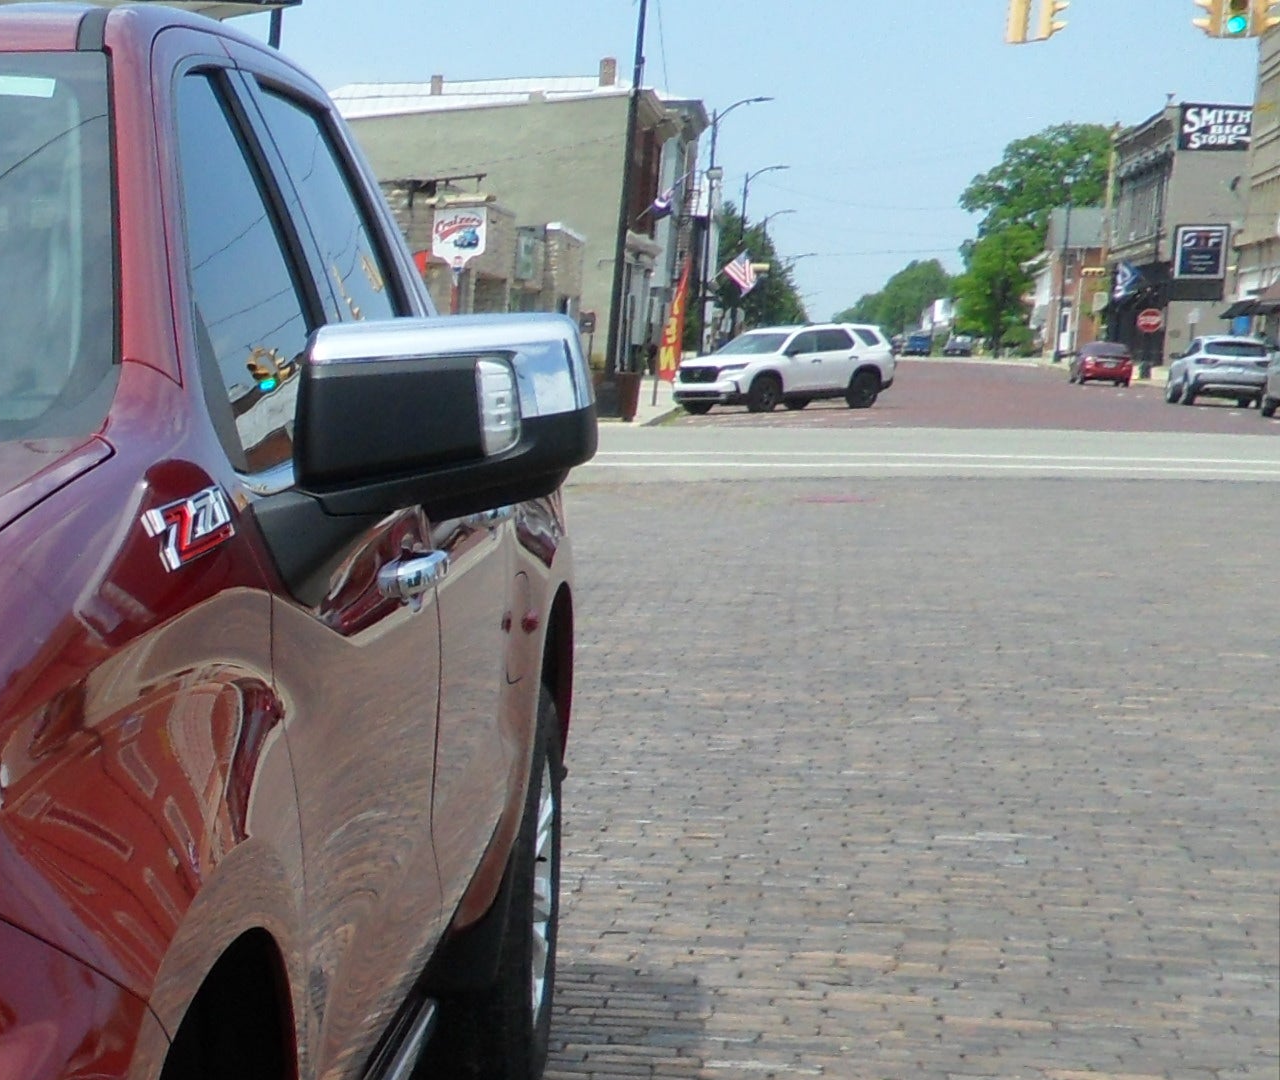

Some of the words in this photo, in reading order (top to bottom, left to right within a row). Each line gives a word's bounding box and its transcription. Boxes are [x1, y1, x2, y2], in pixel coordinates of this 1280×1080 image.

[1183, 108, 1252, 133] SMITH
[1210, 124, 1248, 134] BIG
[1187, 132, 1251, 149] STORE
